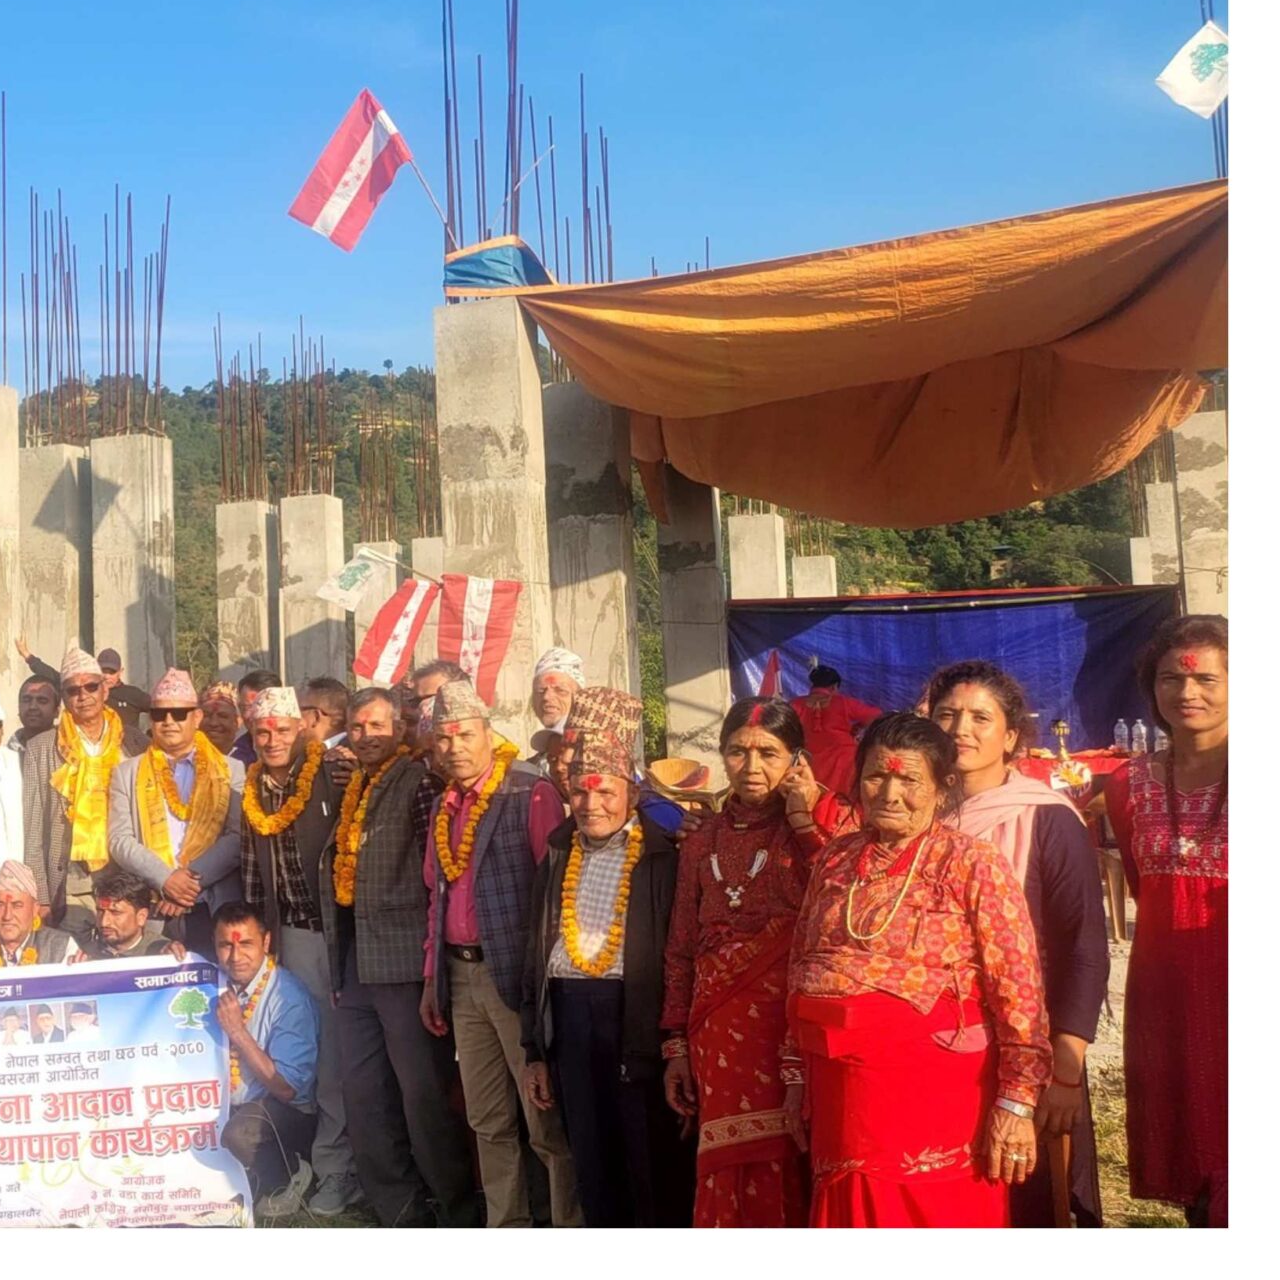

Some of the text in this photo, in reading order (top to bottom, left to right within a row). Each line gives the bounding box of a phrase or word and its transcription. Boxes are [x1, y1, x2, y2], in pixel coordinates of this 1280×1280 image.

[134, 970, 198, 989] समाजवाद
[5, 1053, 39, 1069] नेपाल
[87, 1049, 110, 1064] तथा
[115, 1047, 135, 1060] छठ
[141, 1044, 158, 1058] पर्व
[46, 1066, 99, 1083] आयोजित
[41, 1086, 134, 1123] आदान
[143, 1079, 222, 1118] प्रदान
[89, 1119, 220, 1160] कार्यक्रम
[121, 1173, 166, 1186] आयोजक
